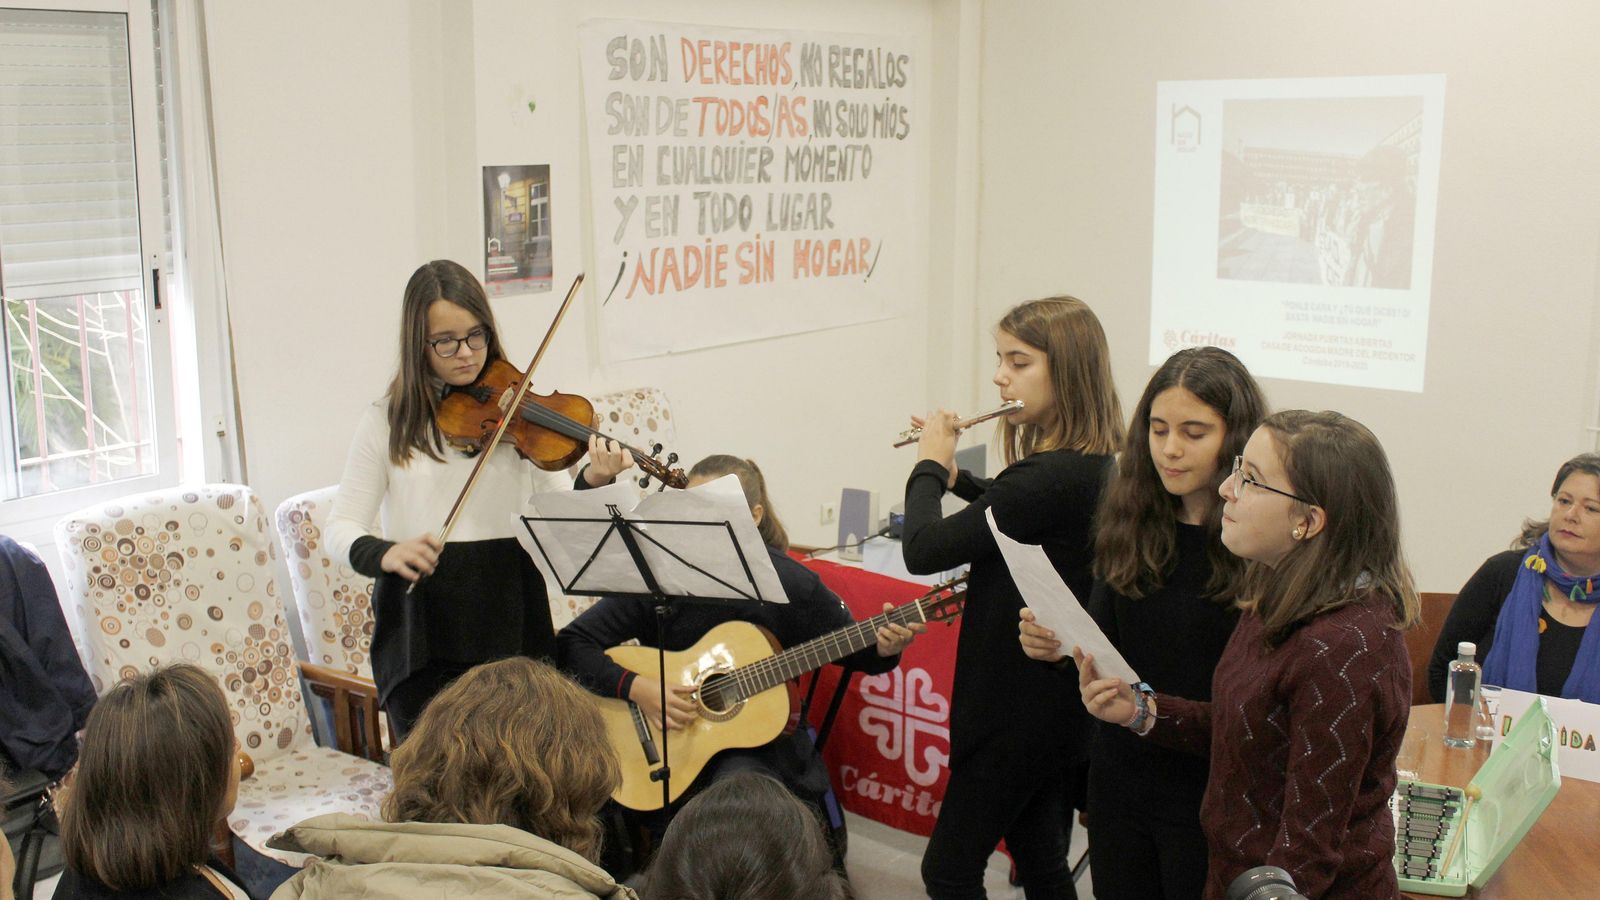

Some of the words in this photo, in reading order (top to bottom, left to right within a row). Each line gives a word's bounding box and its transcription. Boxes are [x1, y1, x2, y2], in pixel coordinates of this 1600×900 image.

[605, 33, 669, 82] SON
[680, 36, 799, 91] DERECHOS,
[799, 41, 824, 88] NO
[828, 44, 909, 90] REGALOS
[604, 91, 650, 137] SON
[655, 98, 690, 137] DE
[812, 99, 832, 139] NO
[835, 99, 869, 139] SOLO
[611, 144, 645, 189] EN
[656, 140, 775, 186] CUALQUIER
[783, 144, 873, 184] MOMENTO
[612, 194, 640, 246] Y
[643, 193, 681, 239] EN
[693, 191, 754, 236] TODO
[765, 192, 836, 232] LUGAR
[735, 233, 776, 286] SIN
